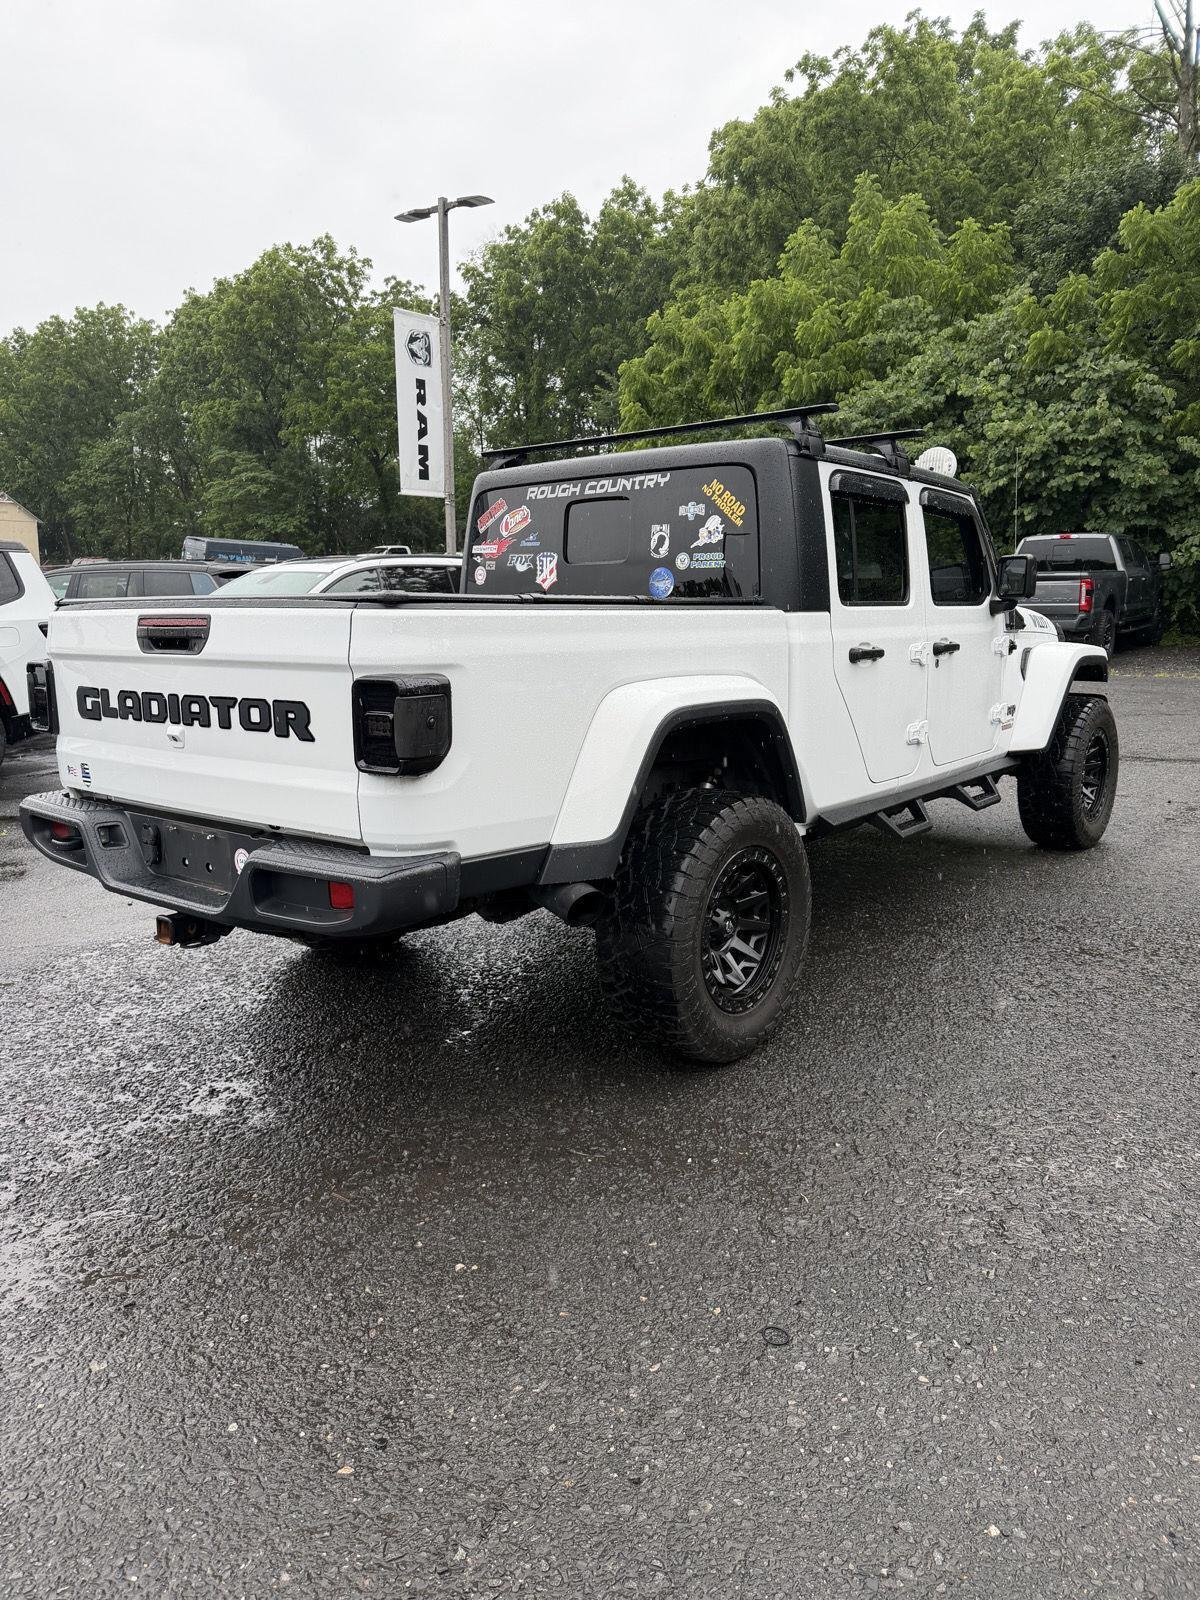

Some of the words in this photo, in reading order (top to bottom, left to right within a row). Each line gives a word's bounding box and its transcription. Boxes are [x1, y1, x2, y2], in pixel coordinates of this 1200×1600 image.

[416, 378, 429, 480] RAM
[526, 483, 581, 500] ROUGH
[584, 473, 671, 495] COUNTRY
[710, 479, 724, 495] NO
[721, 490, 746, 516] ROAD
[701, 484, 713, 496] NO
[711, 493, 744, 527] PROBLEM
[508, 554, 532, 567] FOX
[690, 560, 726, 568] PARENT
[692, 552, 724, 561] PROUD
[76, 685, 316, 742] GLADIATOR
